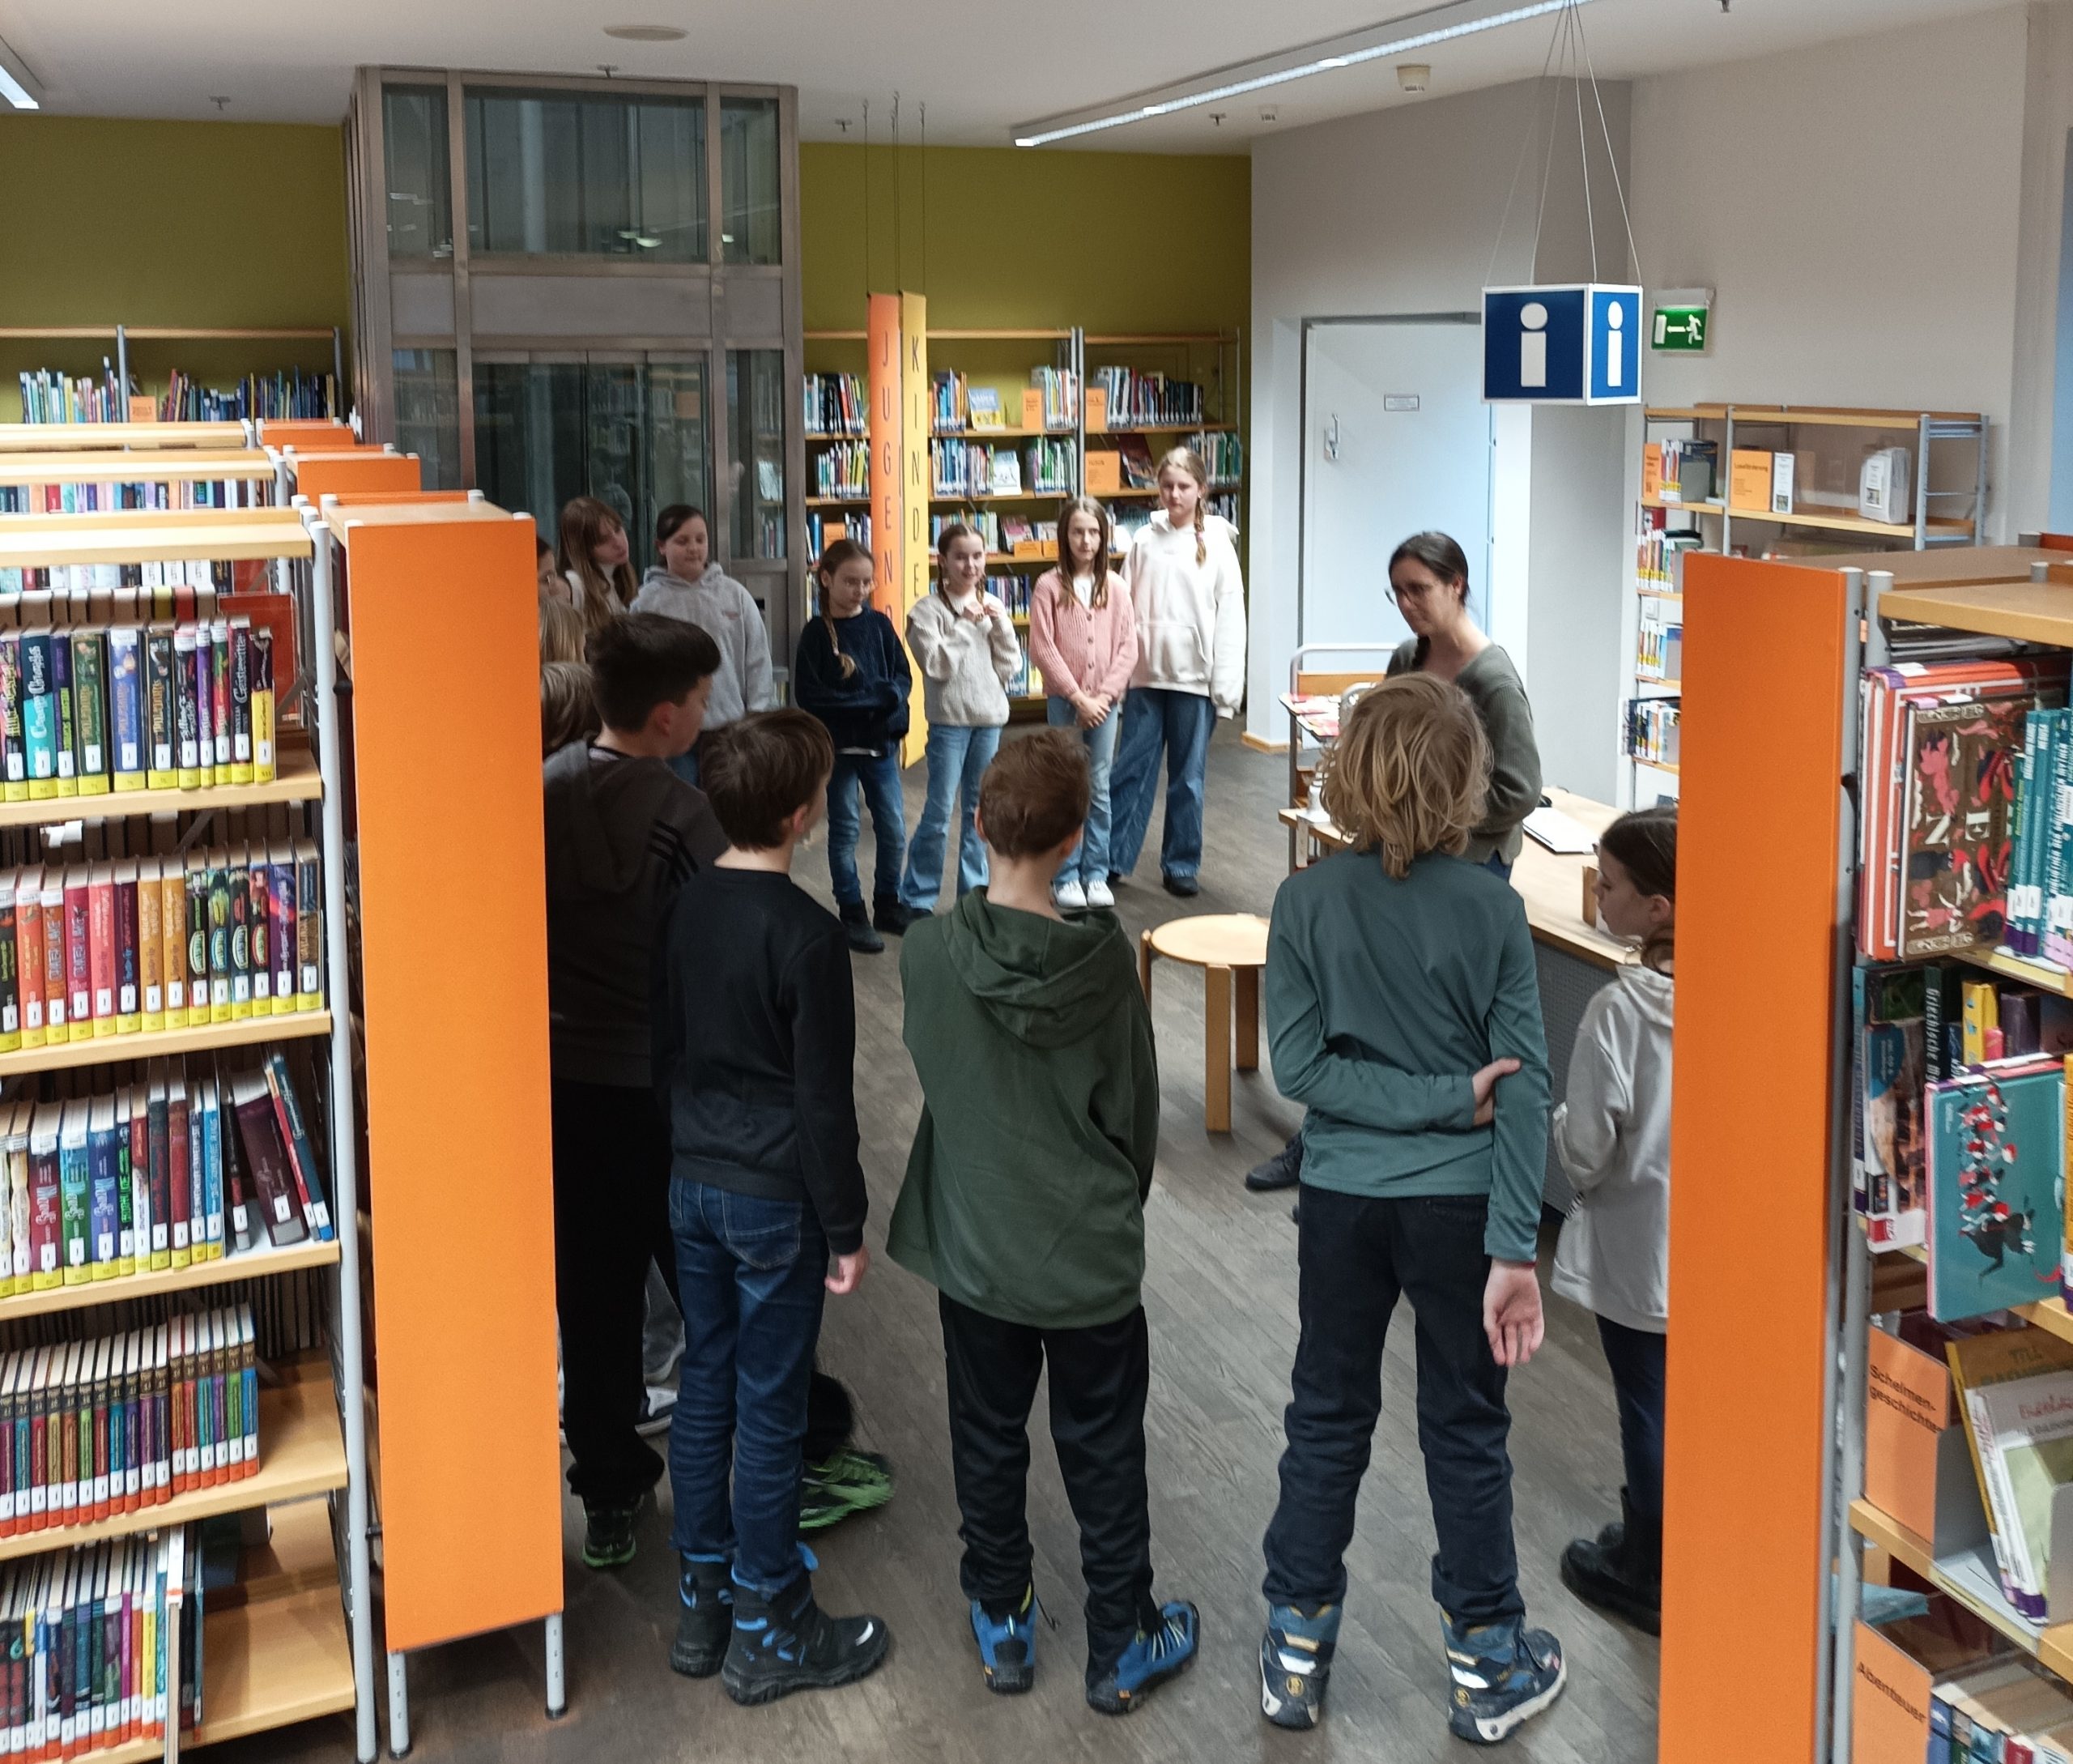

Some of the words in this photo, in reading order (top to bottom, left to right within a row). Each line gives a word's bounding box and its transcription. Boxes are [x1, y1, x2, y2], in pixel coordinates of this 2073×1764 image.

[911, 333, 921, 598] KINDE
[1925, 987, 1940, 1060] Griechische
[1924, 1063, 1939, 1084] My
[1869, 1363, 1937, 1412] Schelmen-
[1856, 1661, 1926, 1724] Abenteuer
